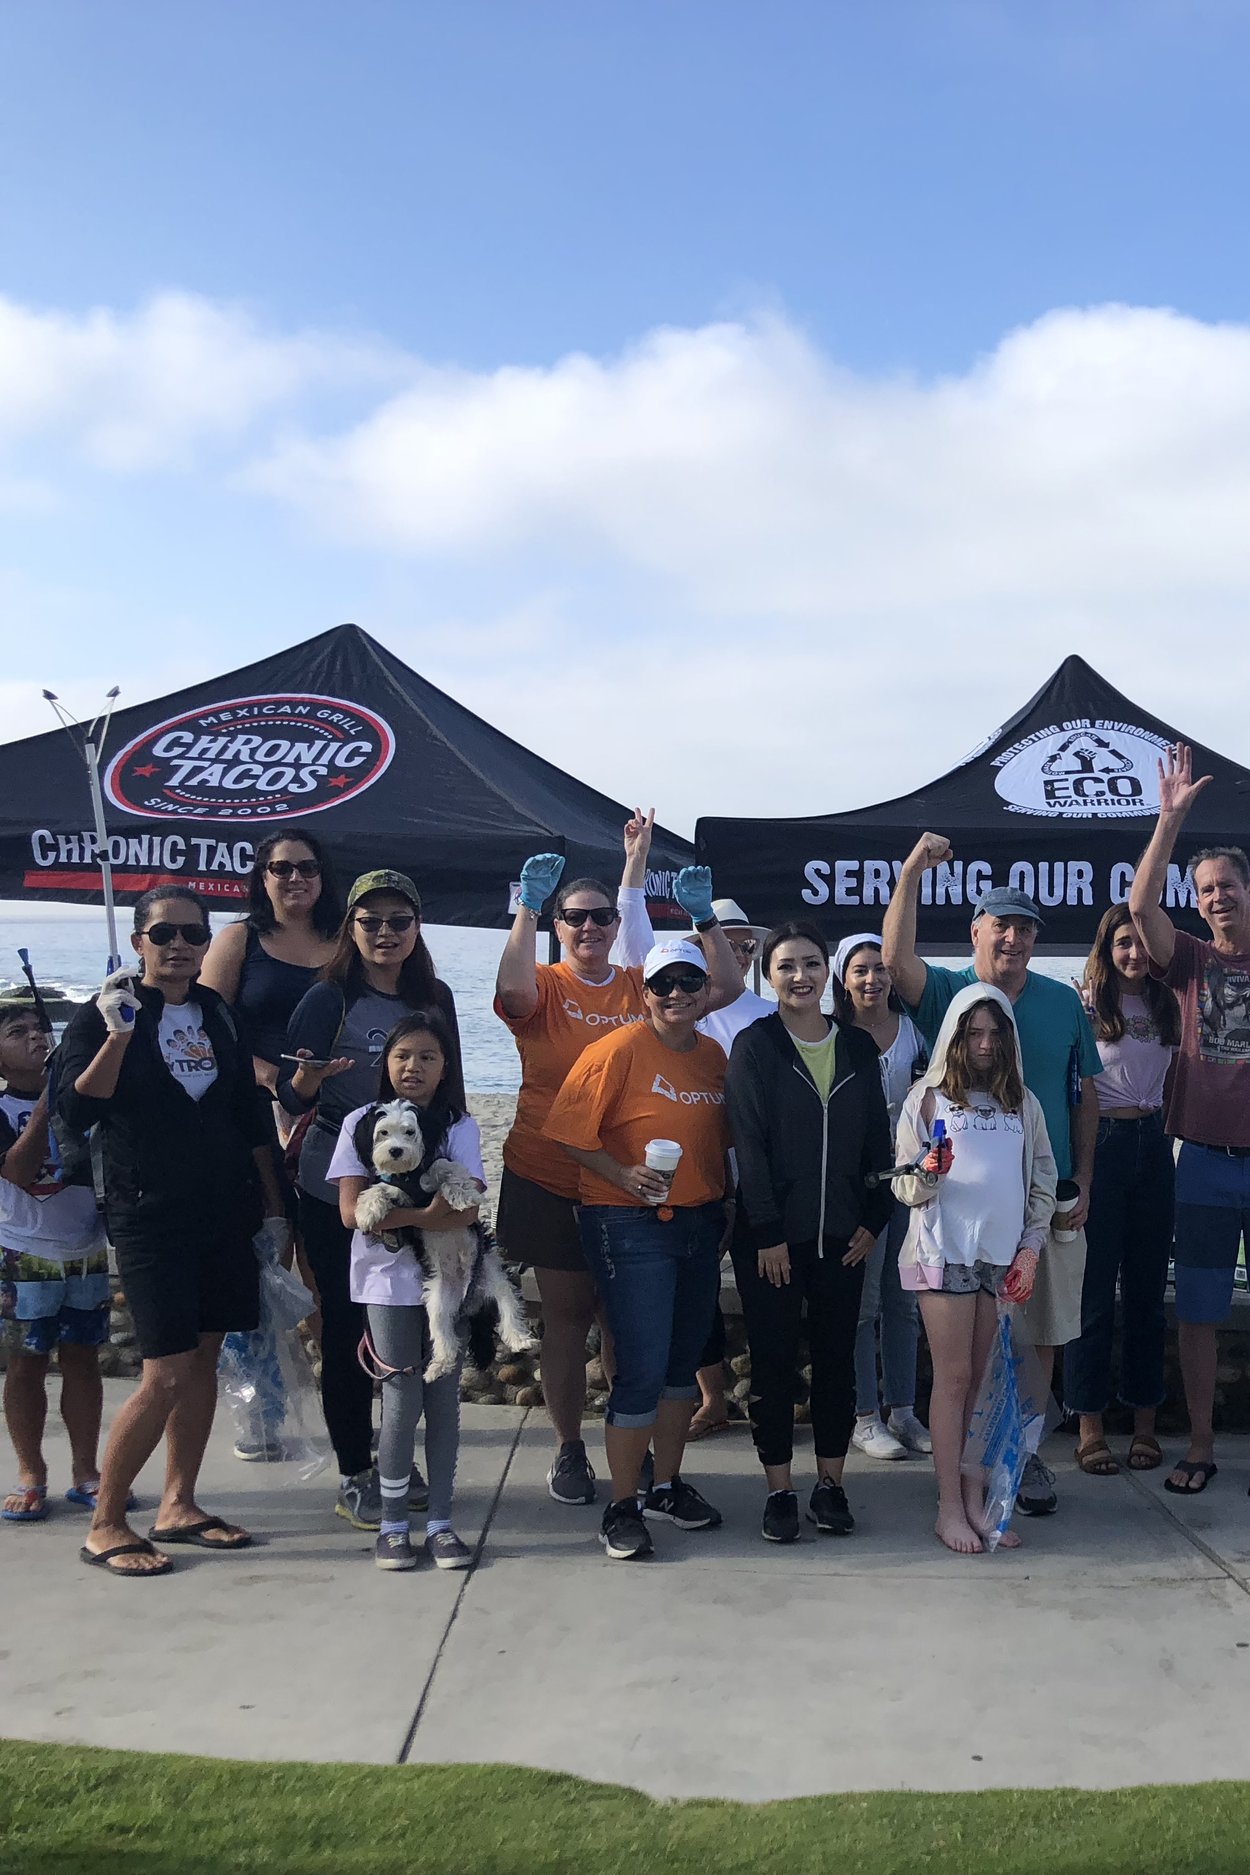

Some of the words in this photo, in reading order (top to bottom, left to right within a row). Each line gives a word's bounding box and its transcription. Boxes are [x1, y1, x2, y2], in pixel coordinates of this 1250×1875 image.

[199, 705, 311, 728] MEXICAN
[316, 709, 365, 736] GRILL
[152, 731, 373, 768] CHRONIC
[990, 725, 1061, 767] PROTECTING
[1062, 719, 1091, 731] OUR
[1095, 720, 1178, 755] ENVIRONMEN
[164, 760, 328, 793] TACOS
[1042, 776, 1143, 800] ECO
[144, 798, 209, 815] SINCE
[217, 803, 290, 816] 2002
[1003, 804, 1059, 818] SERVING
[1045, 798, 1145, 808] WARRIOR
[31, 829, 187, 870] CHRONIC
[191, 838, 256, 874] TAC
[645, 868, 671, 898] RONIC
[1008, 861, 1094, 906] OUR
[585, 1012, 645, 1026] OPTUM
